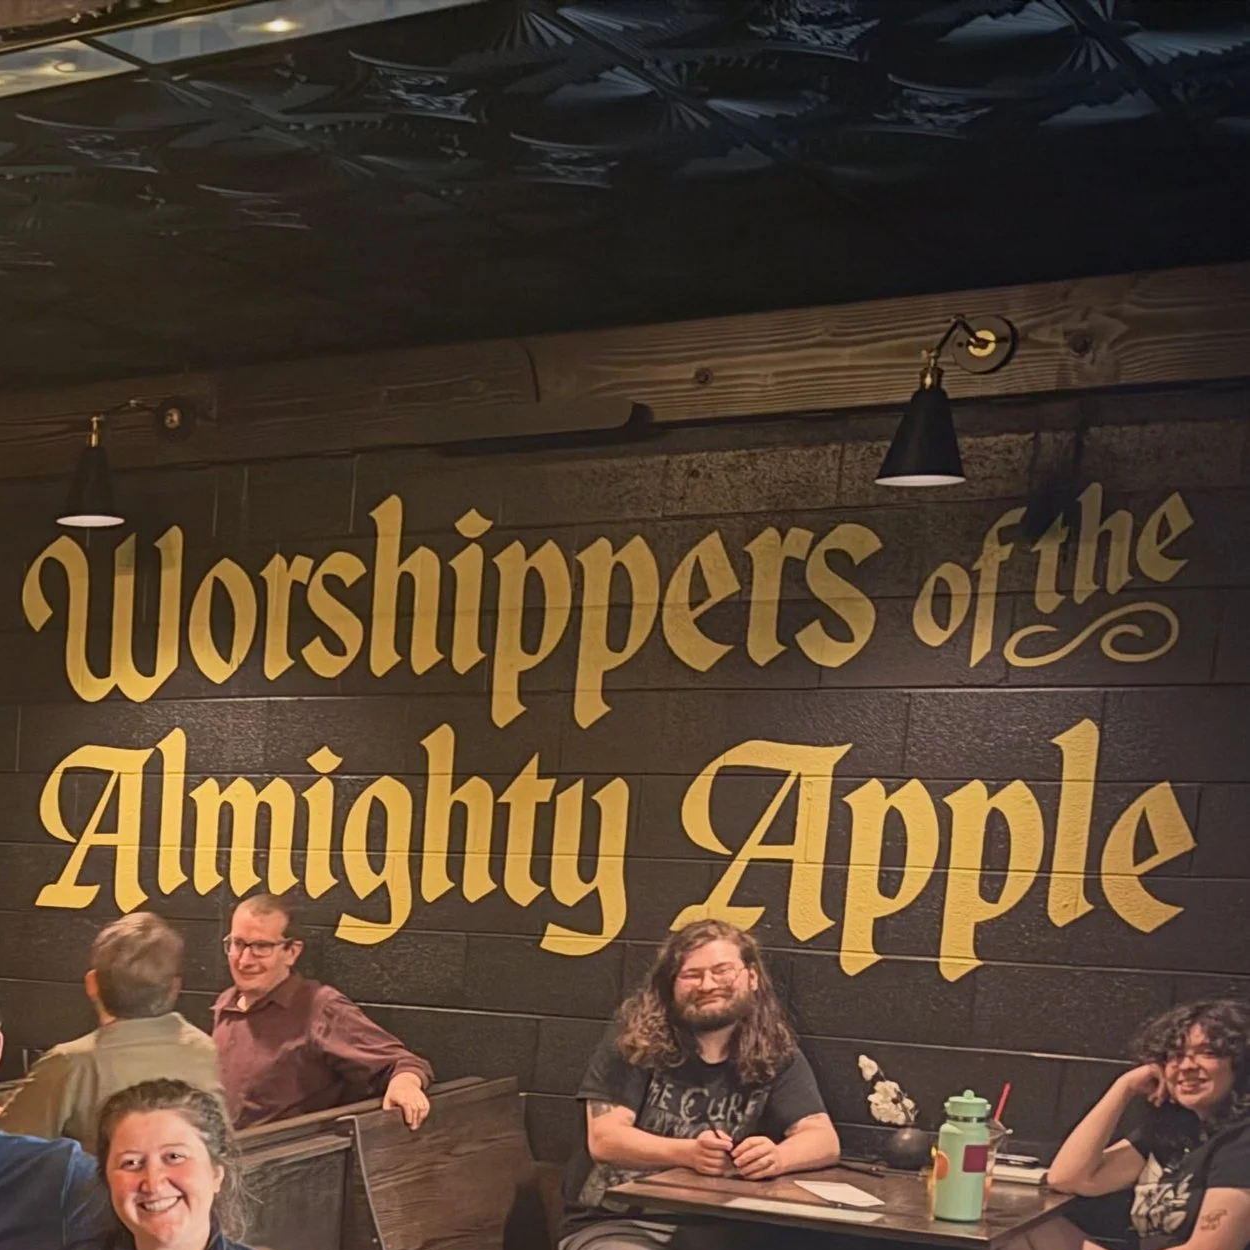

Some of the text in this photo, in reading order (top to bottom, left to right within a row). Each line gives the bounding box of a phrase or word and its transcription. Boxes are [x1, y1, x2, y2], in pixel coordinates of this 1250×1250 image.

[22, 482, 1194, 729] Worshippers of the
[35, 718, 1197, 982] Almighty Apple
